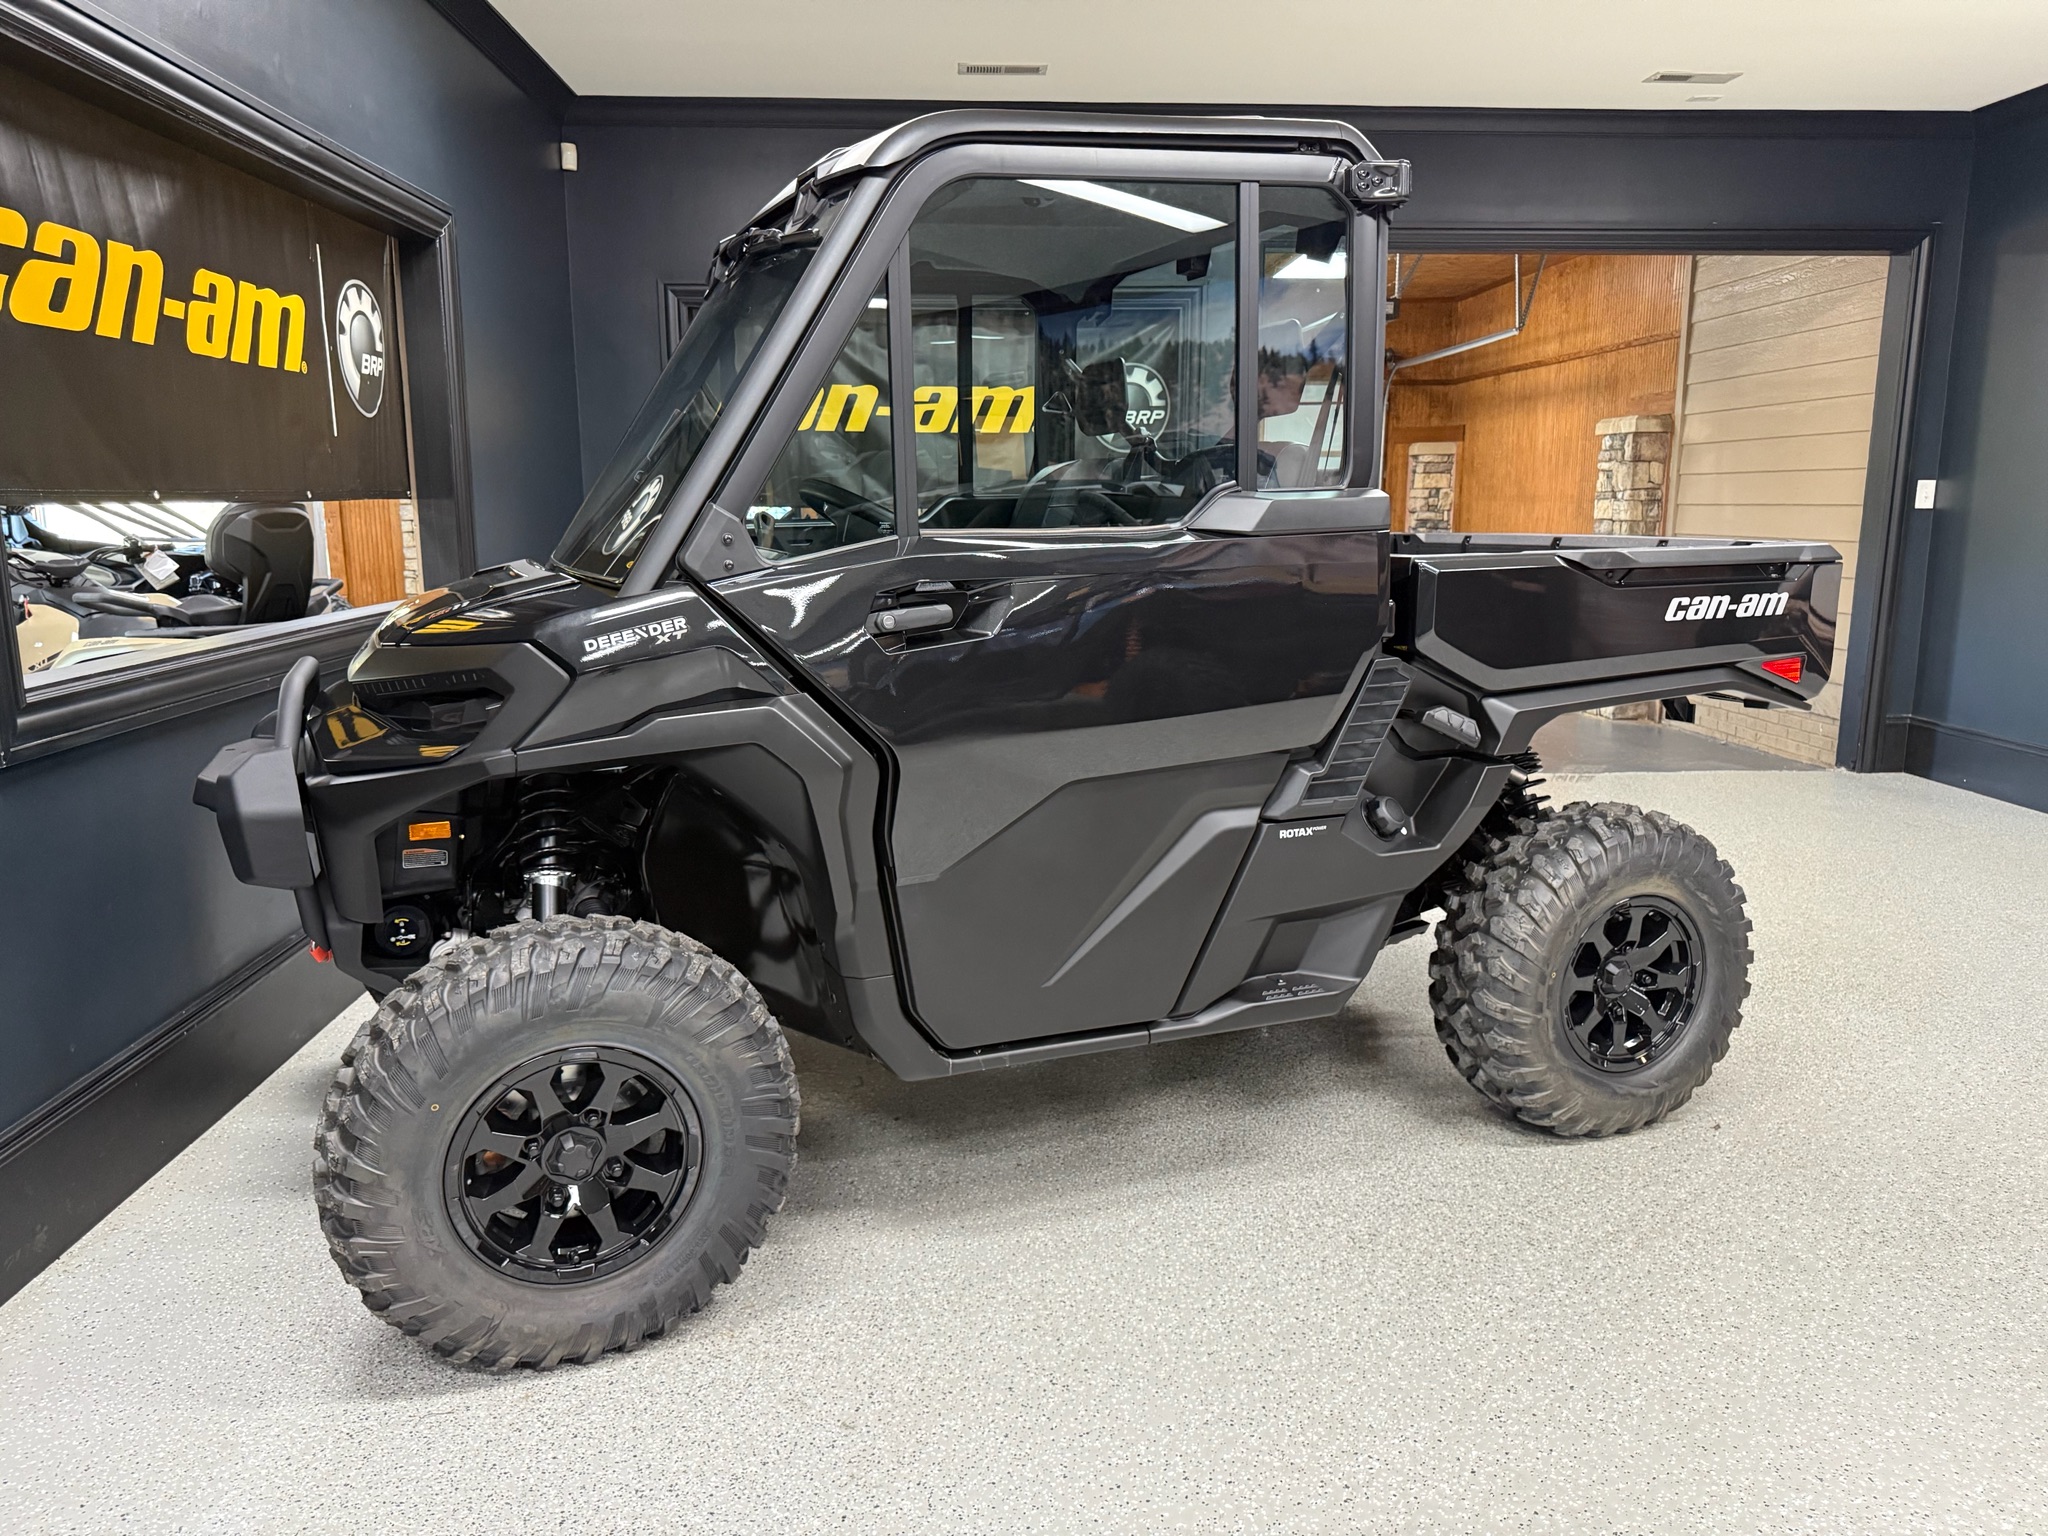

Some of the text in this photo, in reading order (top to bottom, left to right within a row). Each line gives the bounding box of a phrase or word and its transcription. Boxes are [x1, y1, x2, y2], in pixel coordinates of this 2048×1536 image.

[361, 353, 383, 377] BRP
[1126, 410, 1165, 424] BRP
[1664, 591, 1789, 622] can-am
[583, 617, 688, 652] DEFENDER
[655, 629, 688, 645] XT
[1279, 827, 1313, 839] ROTAX
